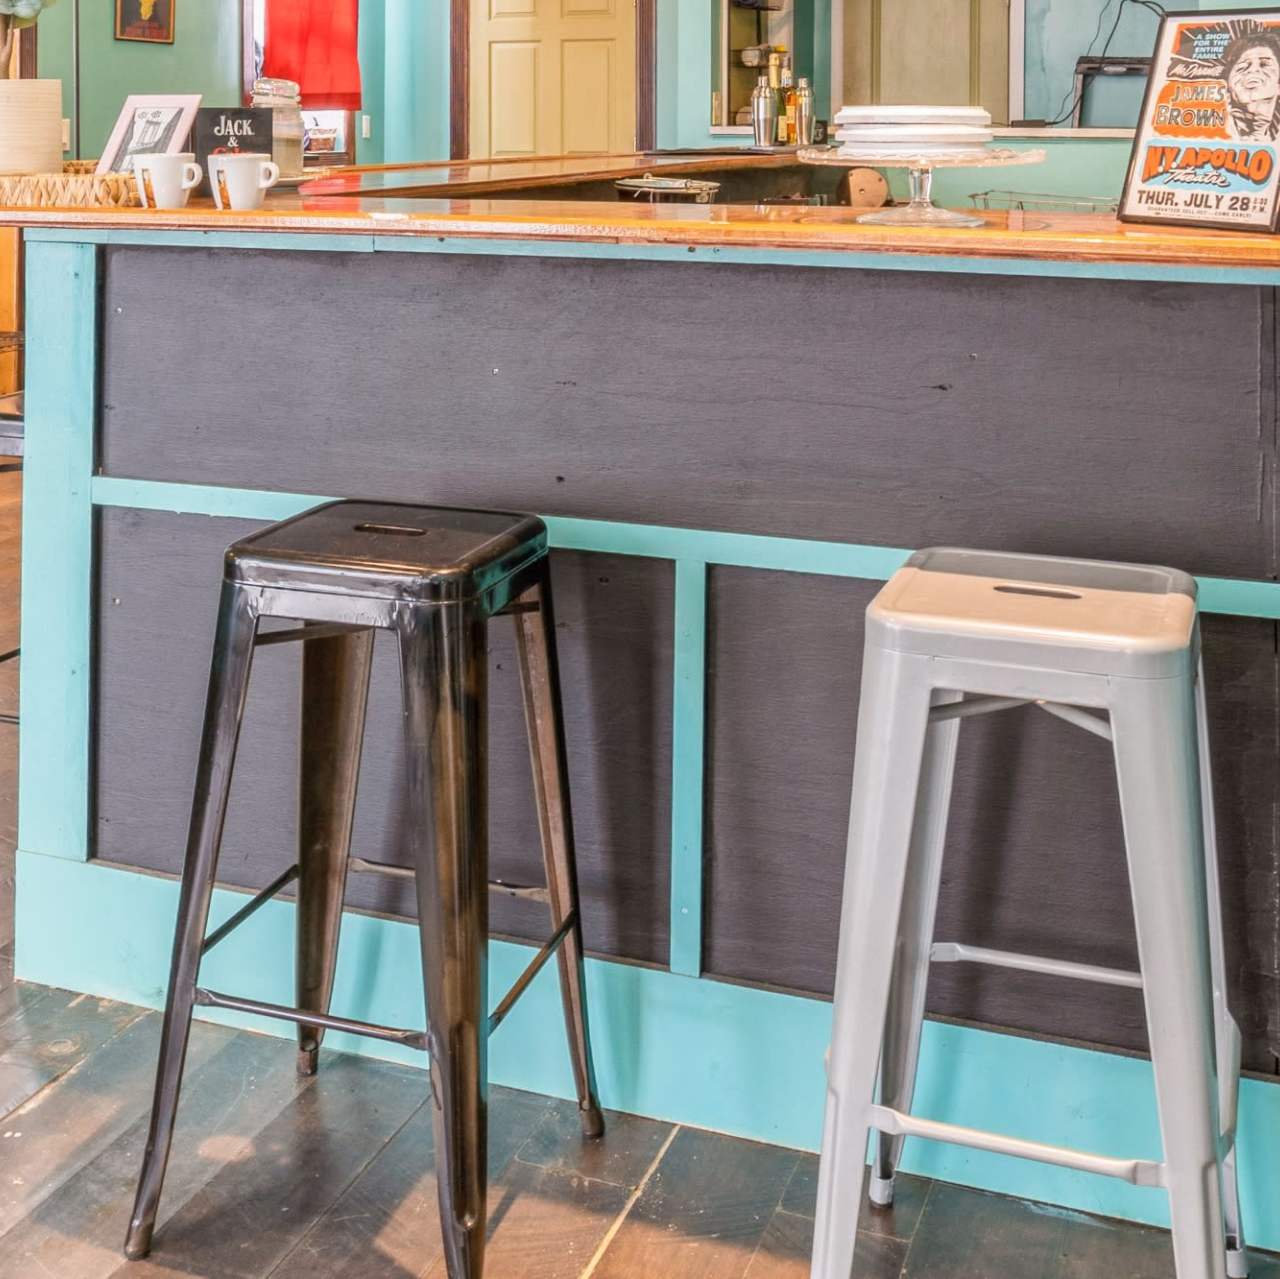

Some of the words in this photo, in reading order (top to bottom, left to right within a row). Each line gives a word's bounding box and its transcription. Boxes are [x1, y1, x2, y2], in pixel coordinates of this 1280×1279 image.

[1172, 85, 1226, 103] JAMES
[213, 115, 256, 136] JACK
[1156, 104, 1226, 127] BROWN
[227, 136, 239, 147] &
[1141, 145, 1180, 183] N.Y.
[1179, 147, 1273, 185] APOLLO
[1164, 167, 1231, 187] Theatre
[1137, 190, 1179, 206] THUR.
[1184, 193, 1224, 209] JULY
[1228, 196, 1250, 211] 28
